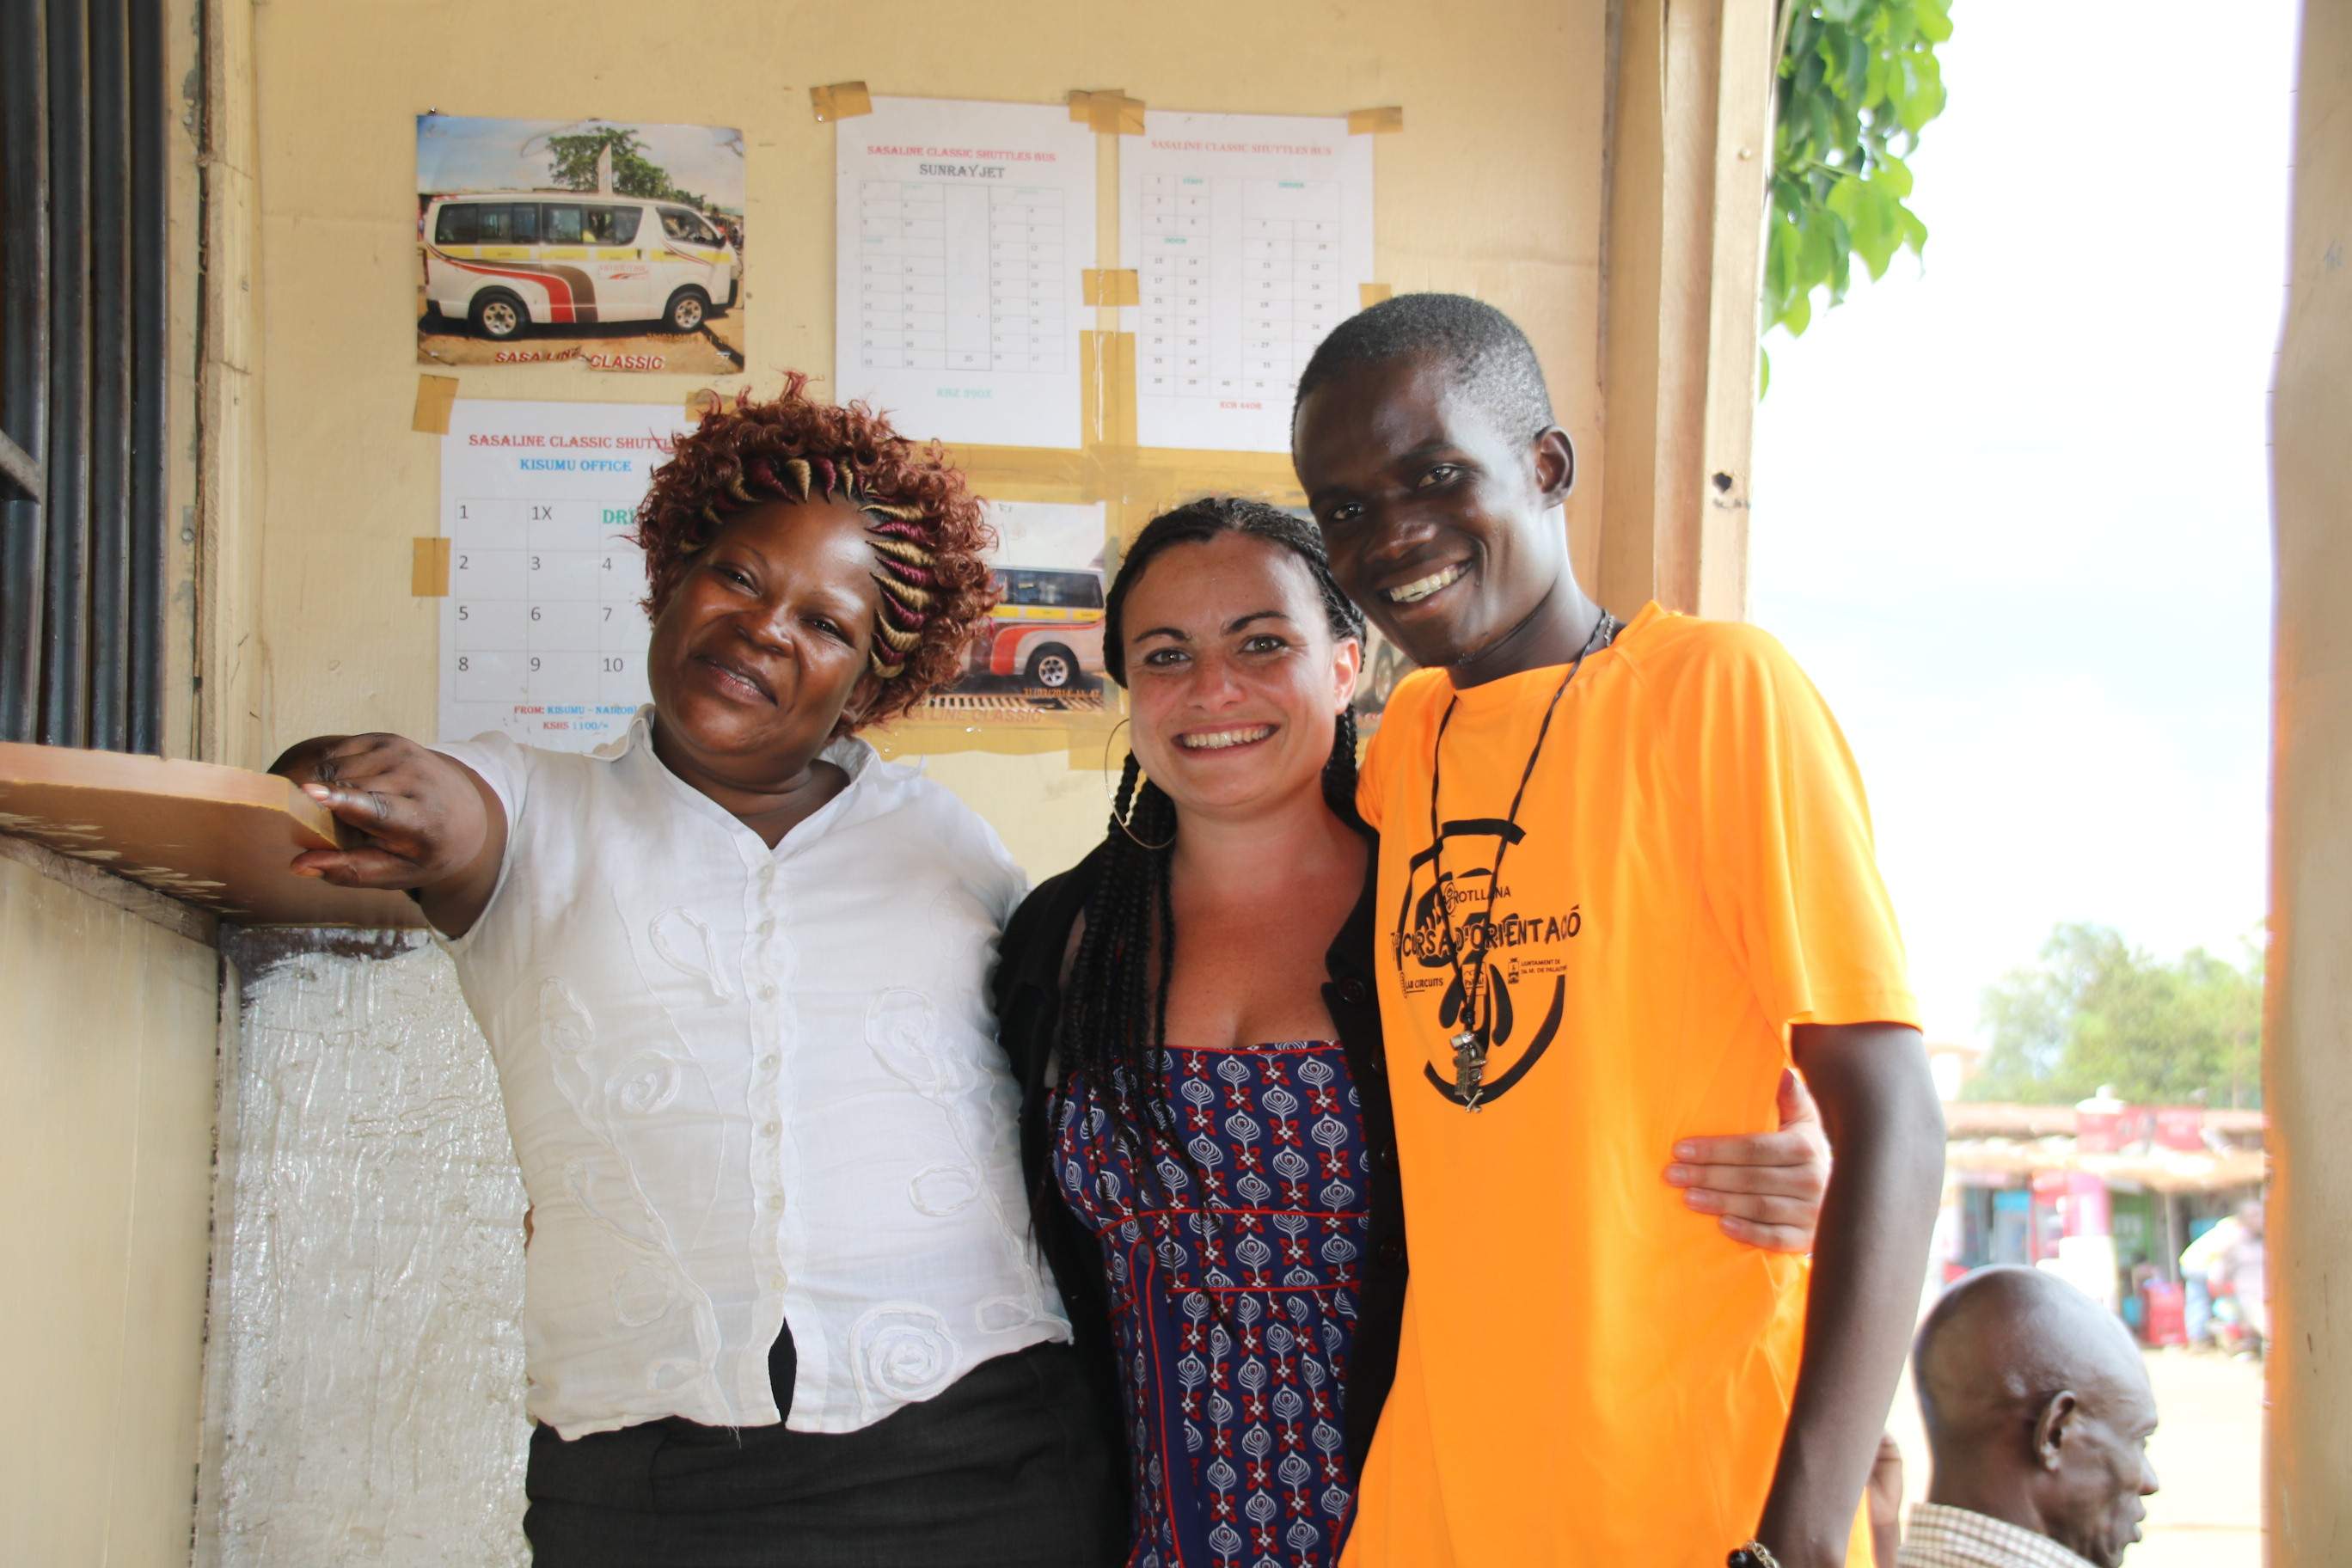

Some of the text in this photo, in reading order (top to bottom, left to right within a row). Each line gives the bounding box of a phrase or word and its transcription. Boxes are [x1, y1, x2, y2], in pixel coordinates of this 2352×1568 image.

[867, 144, 922, 156] SASALINE
[926, 147, 973, 158] CLASSIC
[976, 150, 1032, 162] SHUTTLES
[1151, 140, 1201, 151] SASALINE
[1205, 142, 1247, 153] CLASSIC
[1252, 144, 1308, 155] SHUTTLES
[495, 351, 541, 363] SASA
[591, 353, 664, 371] CLASSIC
[469, 434, 675, 450] SASALINE CLASSIC SHUTTL
[519, 458, 632, 473] KISUMU OFFICE
[458, 504, 635, 525] 1 1X DRI
[458, 554, 612, 572] 2 3 4
[458, 605, 613, 622] 5 6 7
[458, 656, 624, 673] 8 9 10
[513, 704, 545, 715] FROM:
[547, 705, 585, 716] KISUMU
